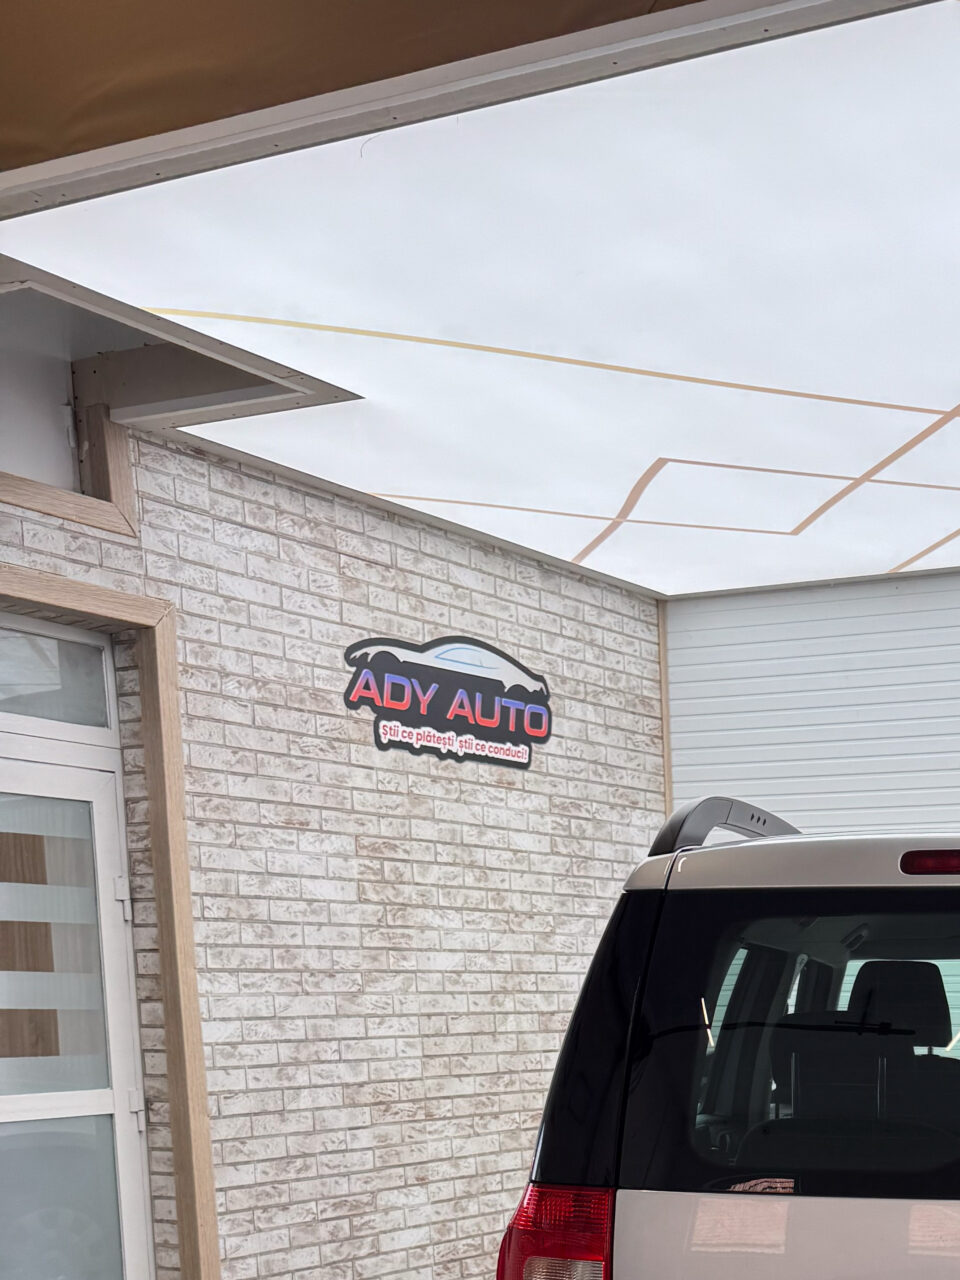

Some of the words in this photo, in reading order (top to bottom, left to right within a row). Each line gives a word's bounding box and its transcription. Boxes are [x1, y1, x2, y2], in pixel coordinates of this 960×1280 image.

[350, 668, 439, 715] ADY
[446, 688, 549, 738] AUTO
[401, 729, 414, 740] ce
[475, 742, 487, 753] ce
[488, 744, 528, 760] conduci!
